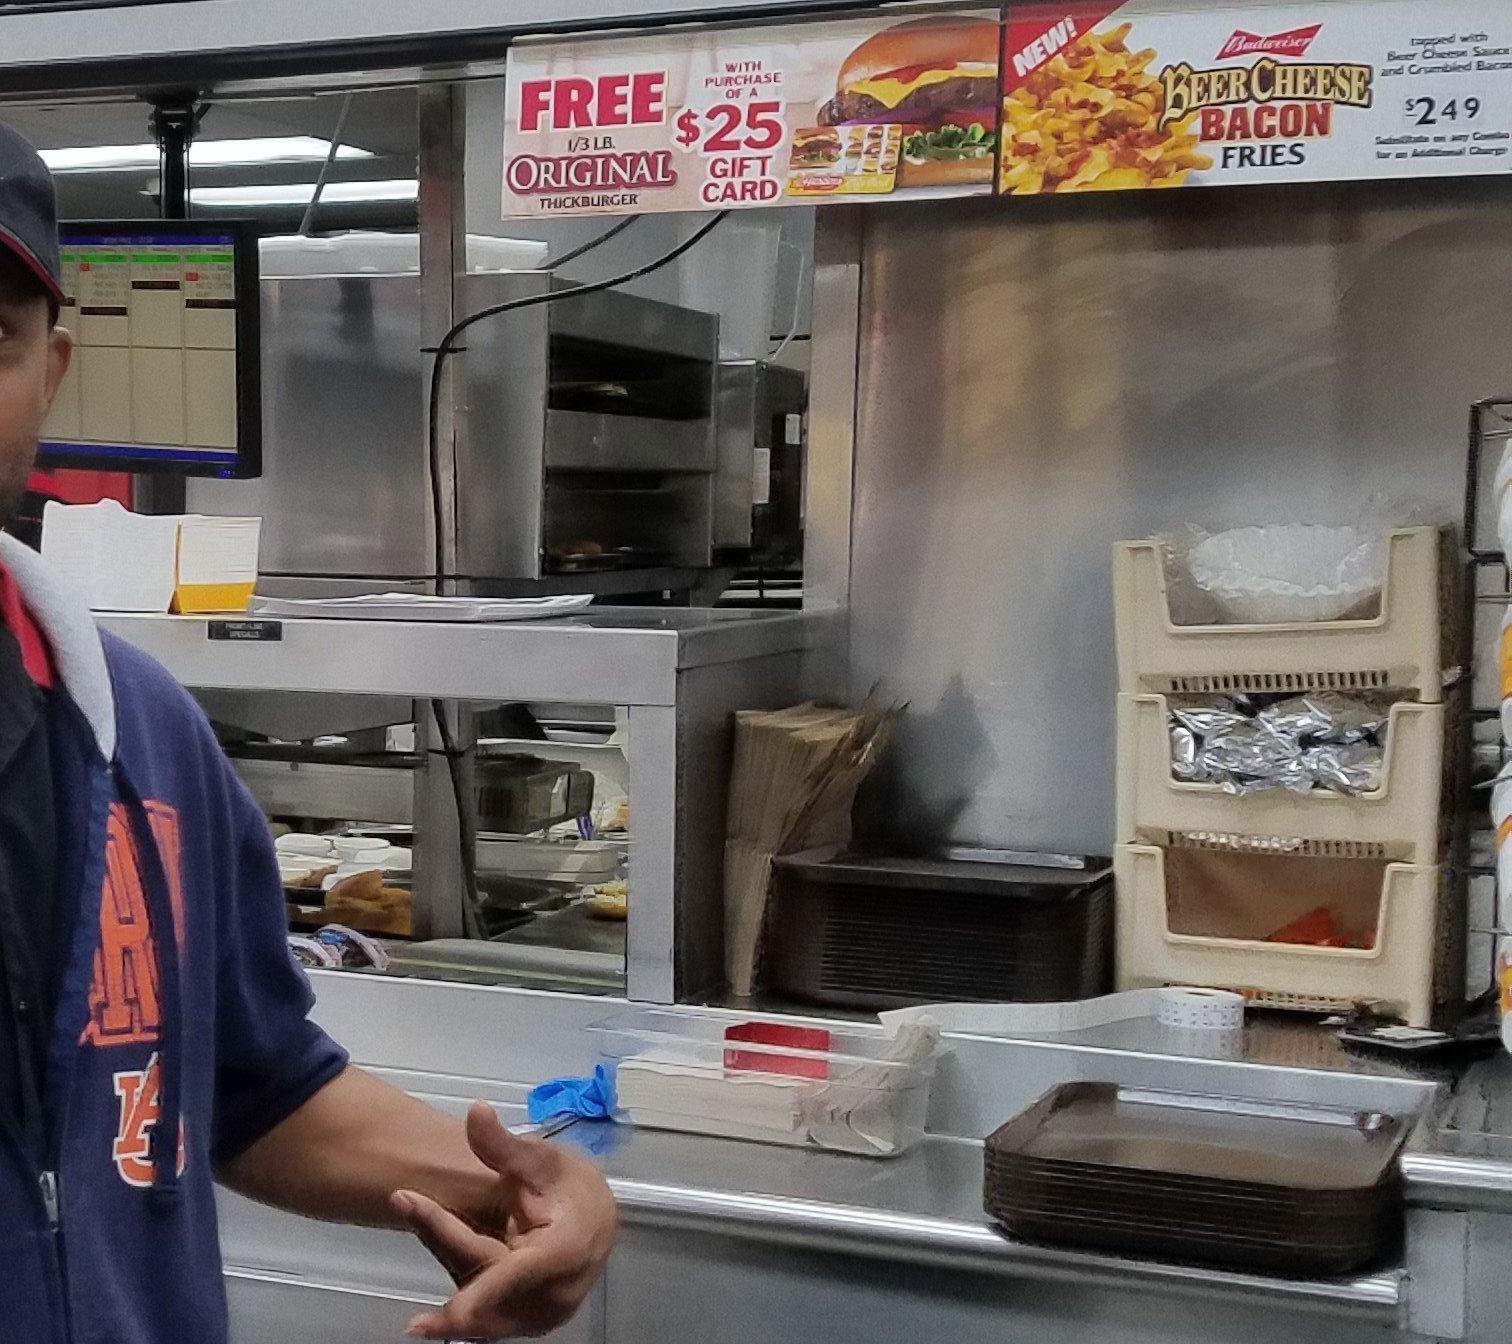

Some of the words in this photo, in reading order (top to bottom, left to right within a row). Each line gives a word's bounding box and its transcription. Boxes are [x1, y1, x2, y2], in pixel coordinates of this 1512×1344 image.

[1012, 15, 1078, 78] NEW!
[704, 72, 782, 88] PURCHASE
[724, 61, 762, 74] WITH
[519, 70, 666, 132] FREE
[724, 88, 742, 100] OF
[749, 88, 758, 98] A
[1159, 61, 1251, 128] BEER
[1251, 58, 1373, 108] CHEESE
[676, 102, 782, 153] $25
[1199, 100, 1333, 142] BACON
[568, 136, 590, 152] 1/3
[594, 137, 616, 150] LB.
[1222, 143, 1306, 169] FRIES
[508, 152, 677, 194] ORIGINAL
[710, 156, 774, 178] GIFT
[540, 194, 638, 210] THICKBURGER
[702, 180, 779, 204] CARD
